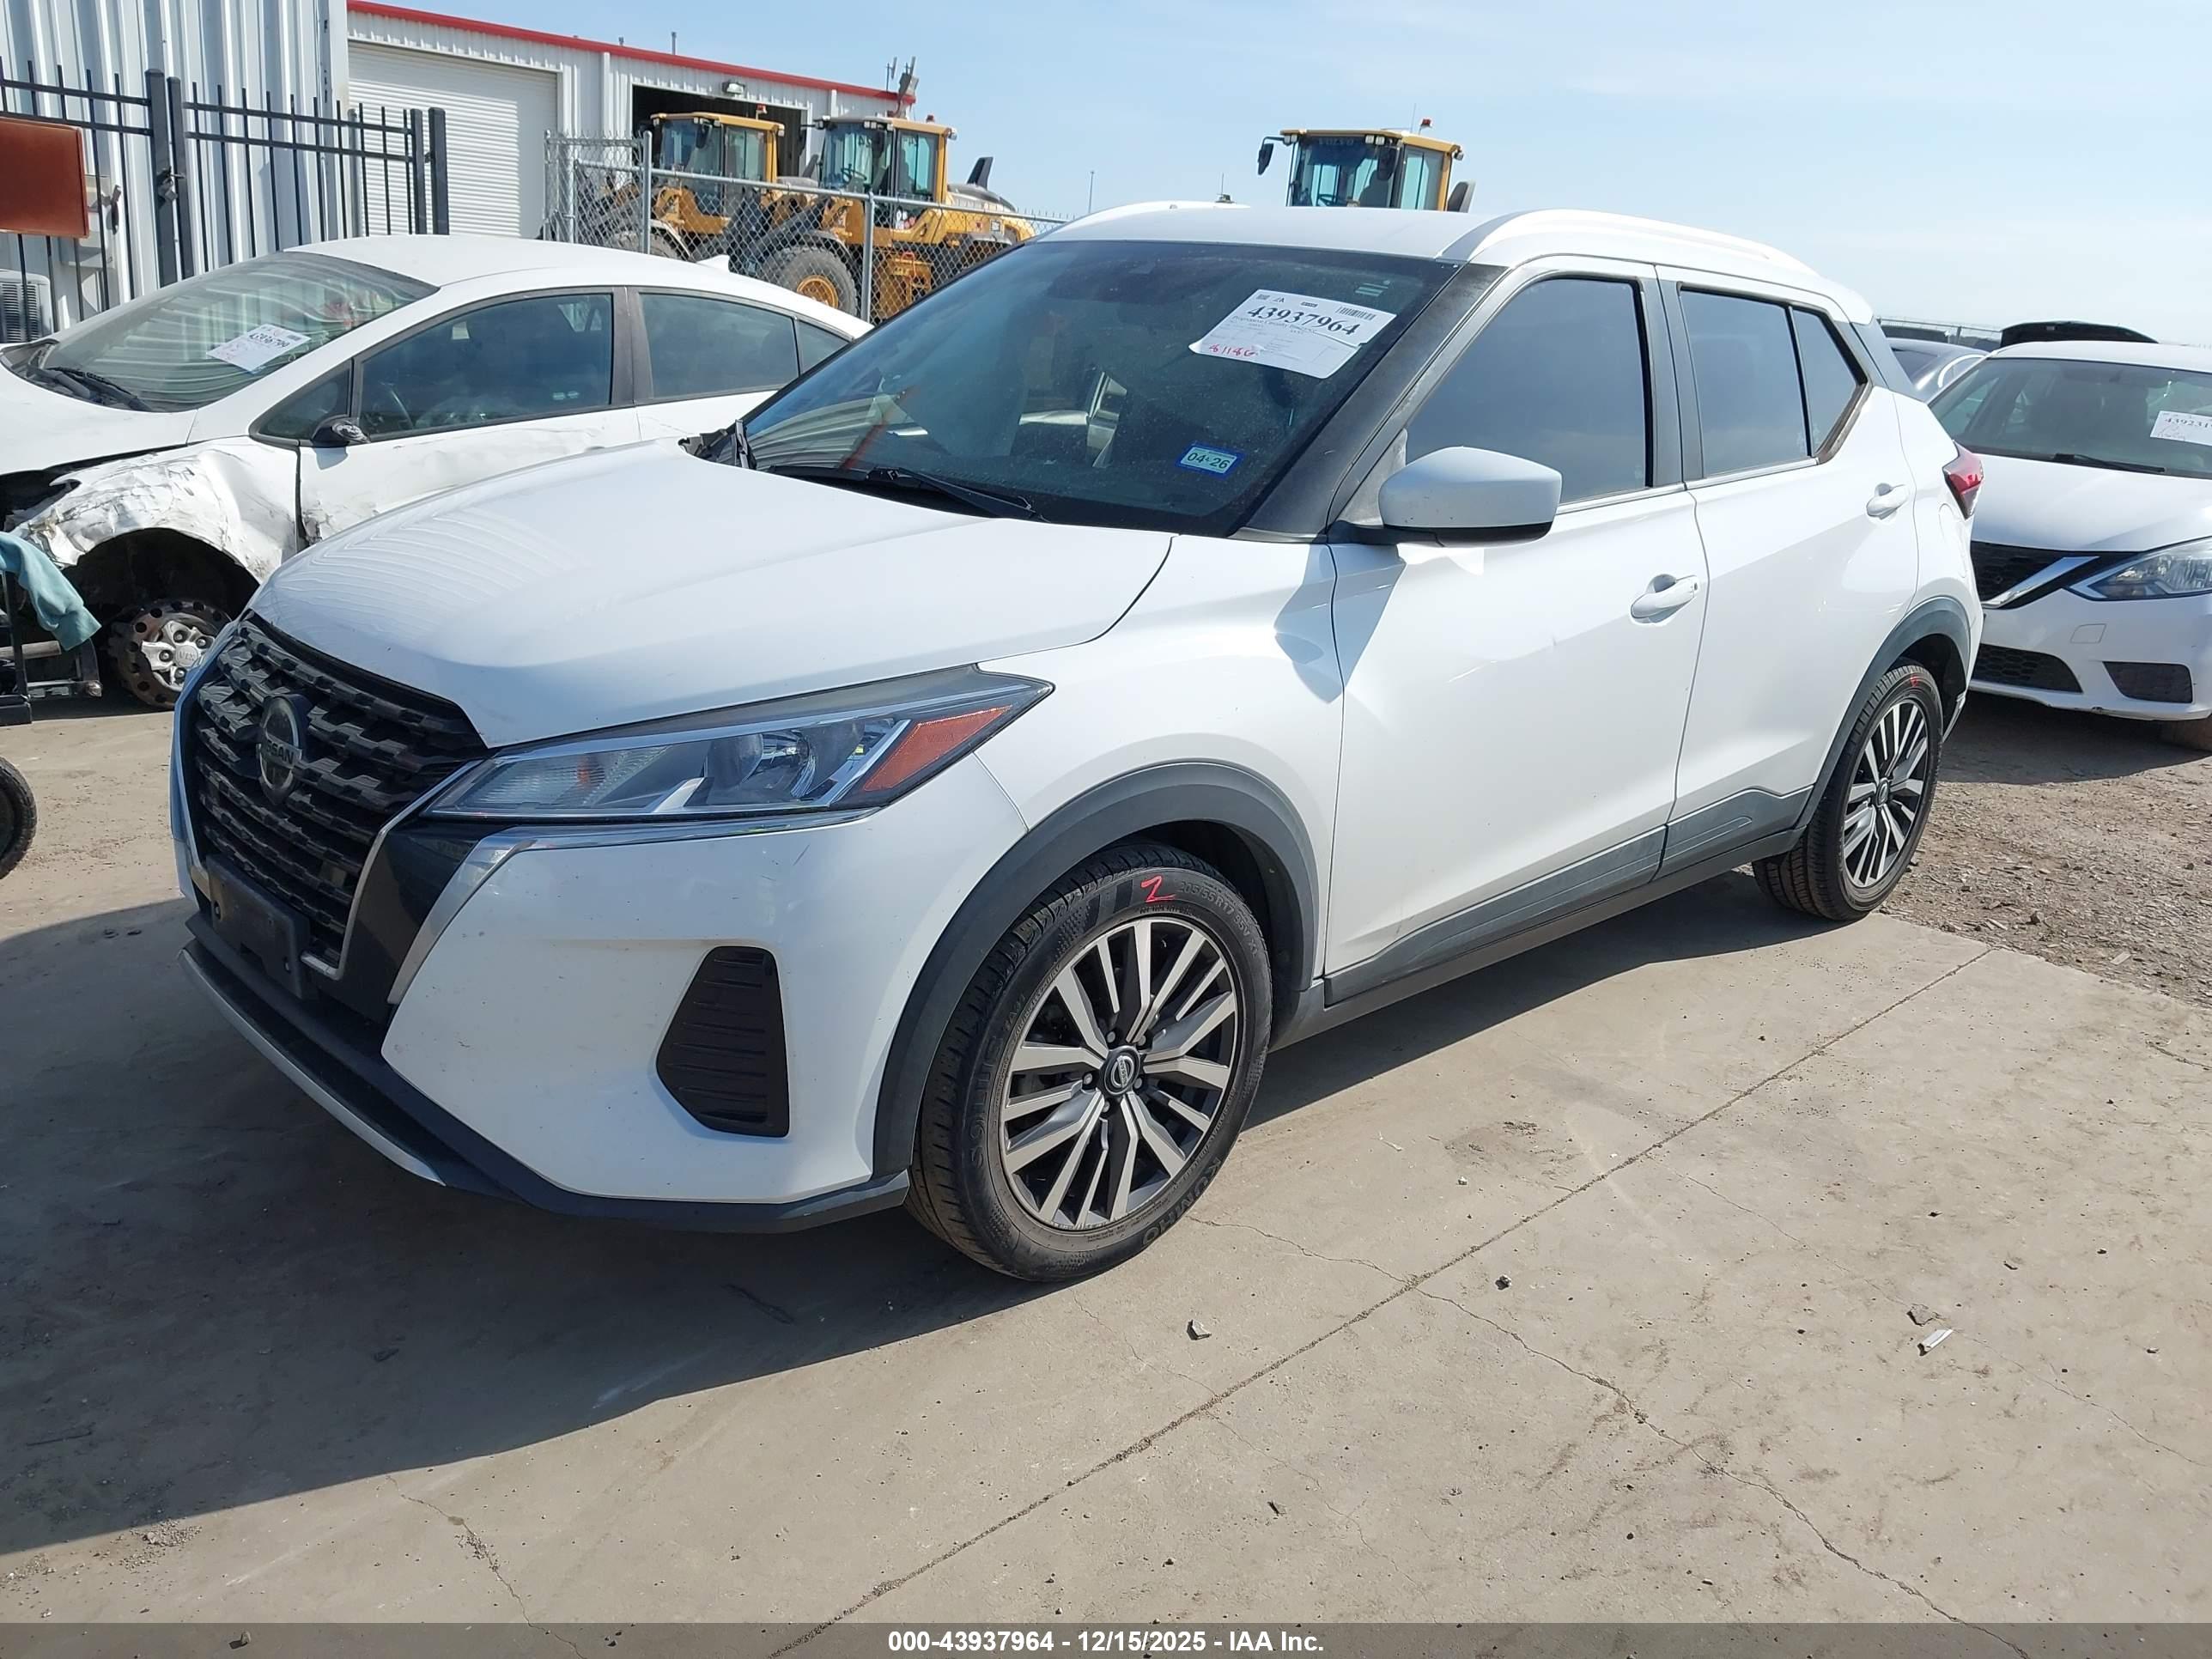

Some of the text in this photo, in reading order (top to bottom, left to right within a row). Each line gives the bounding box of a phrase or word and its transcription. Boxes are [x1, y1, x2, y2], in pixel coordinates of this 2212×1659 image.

[1248, 305, 1361, 336] 43937964
[1210, 457, 1231, 469] 26
[1142, 1157, 1223, 1245] KUMHO
